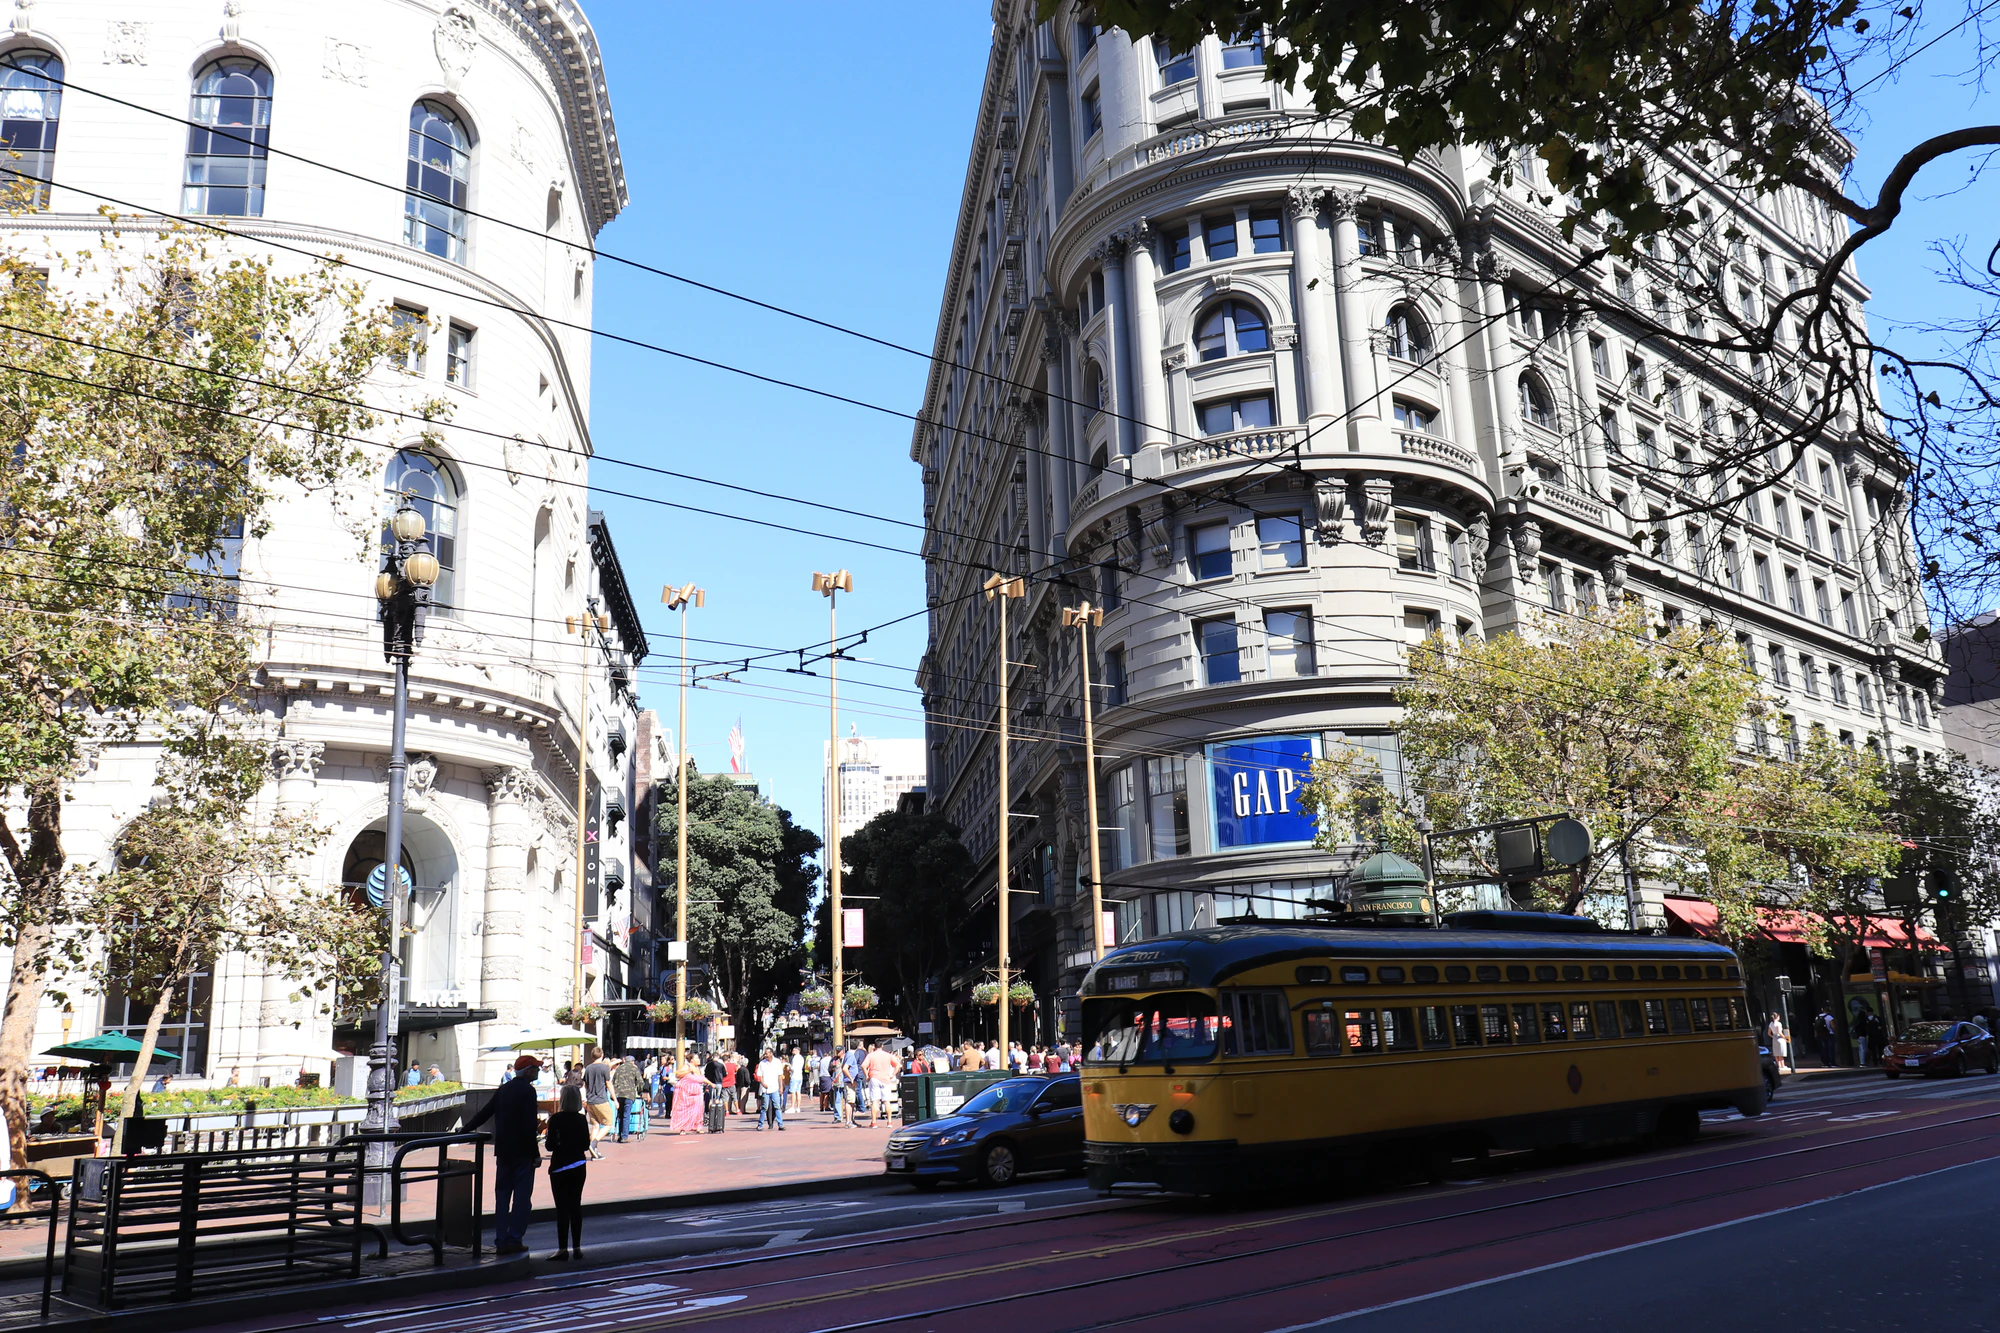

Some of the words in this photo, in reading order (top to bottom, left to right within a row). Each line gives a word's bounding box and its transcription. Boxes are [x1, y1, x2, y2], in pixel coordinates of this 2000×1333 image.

[1233, 768, 1294, 817] GAP
[586, 816, 598, 885] AXIOM
[1359, 904, 1371, 912] SAN
[1371, 901, 1413, 912] FRANCISCO
[416, 989, 462, 1008] AT&T
[937, 1089, 951, 1097] Early
[937, 1098, 962, 1106] adopters
